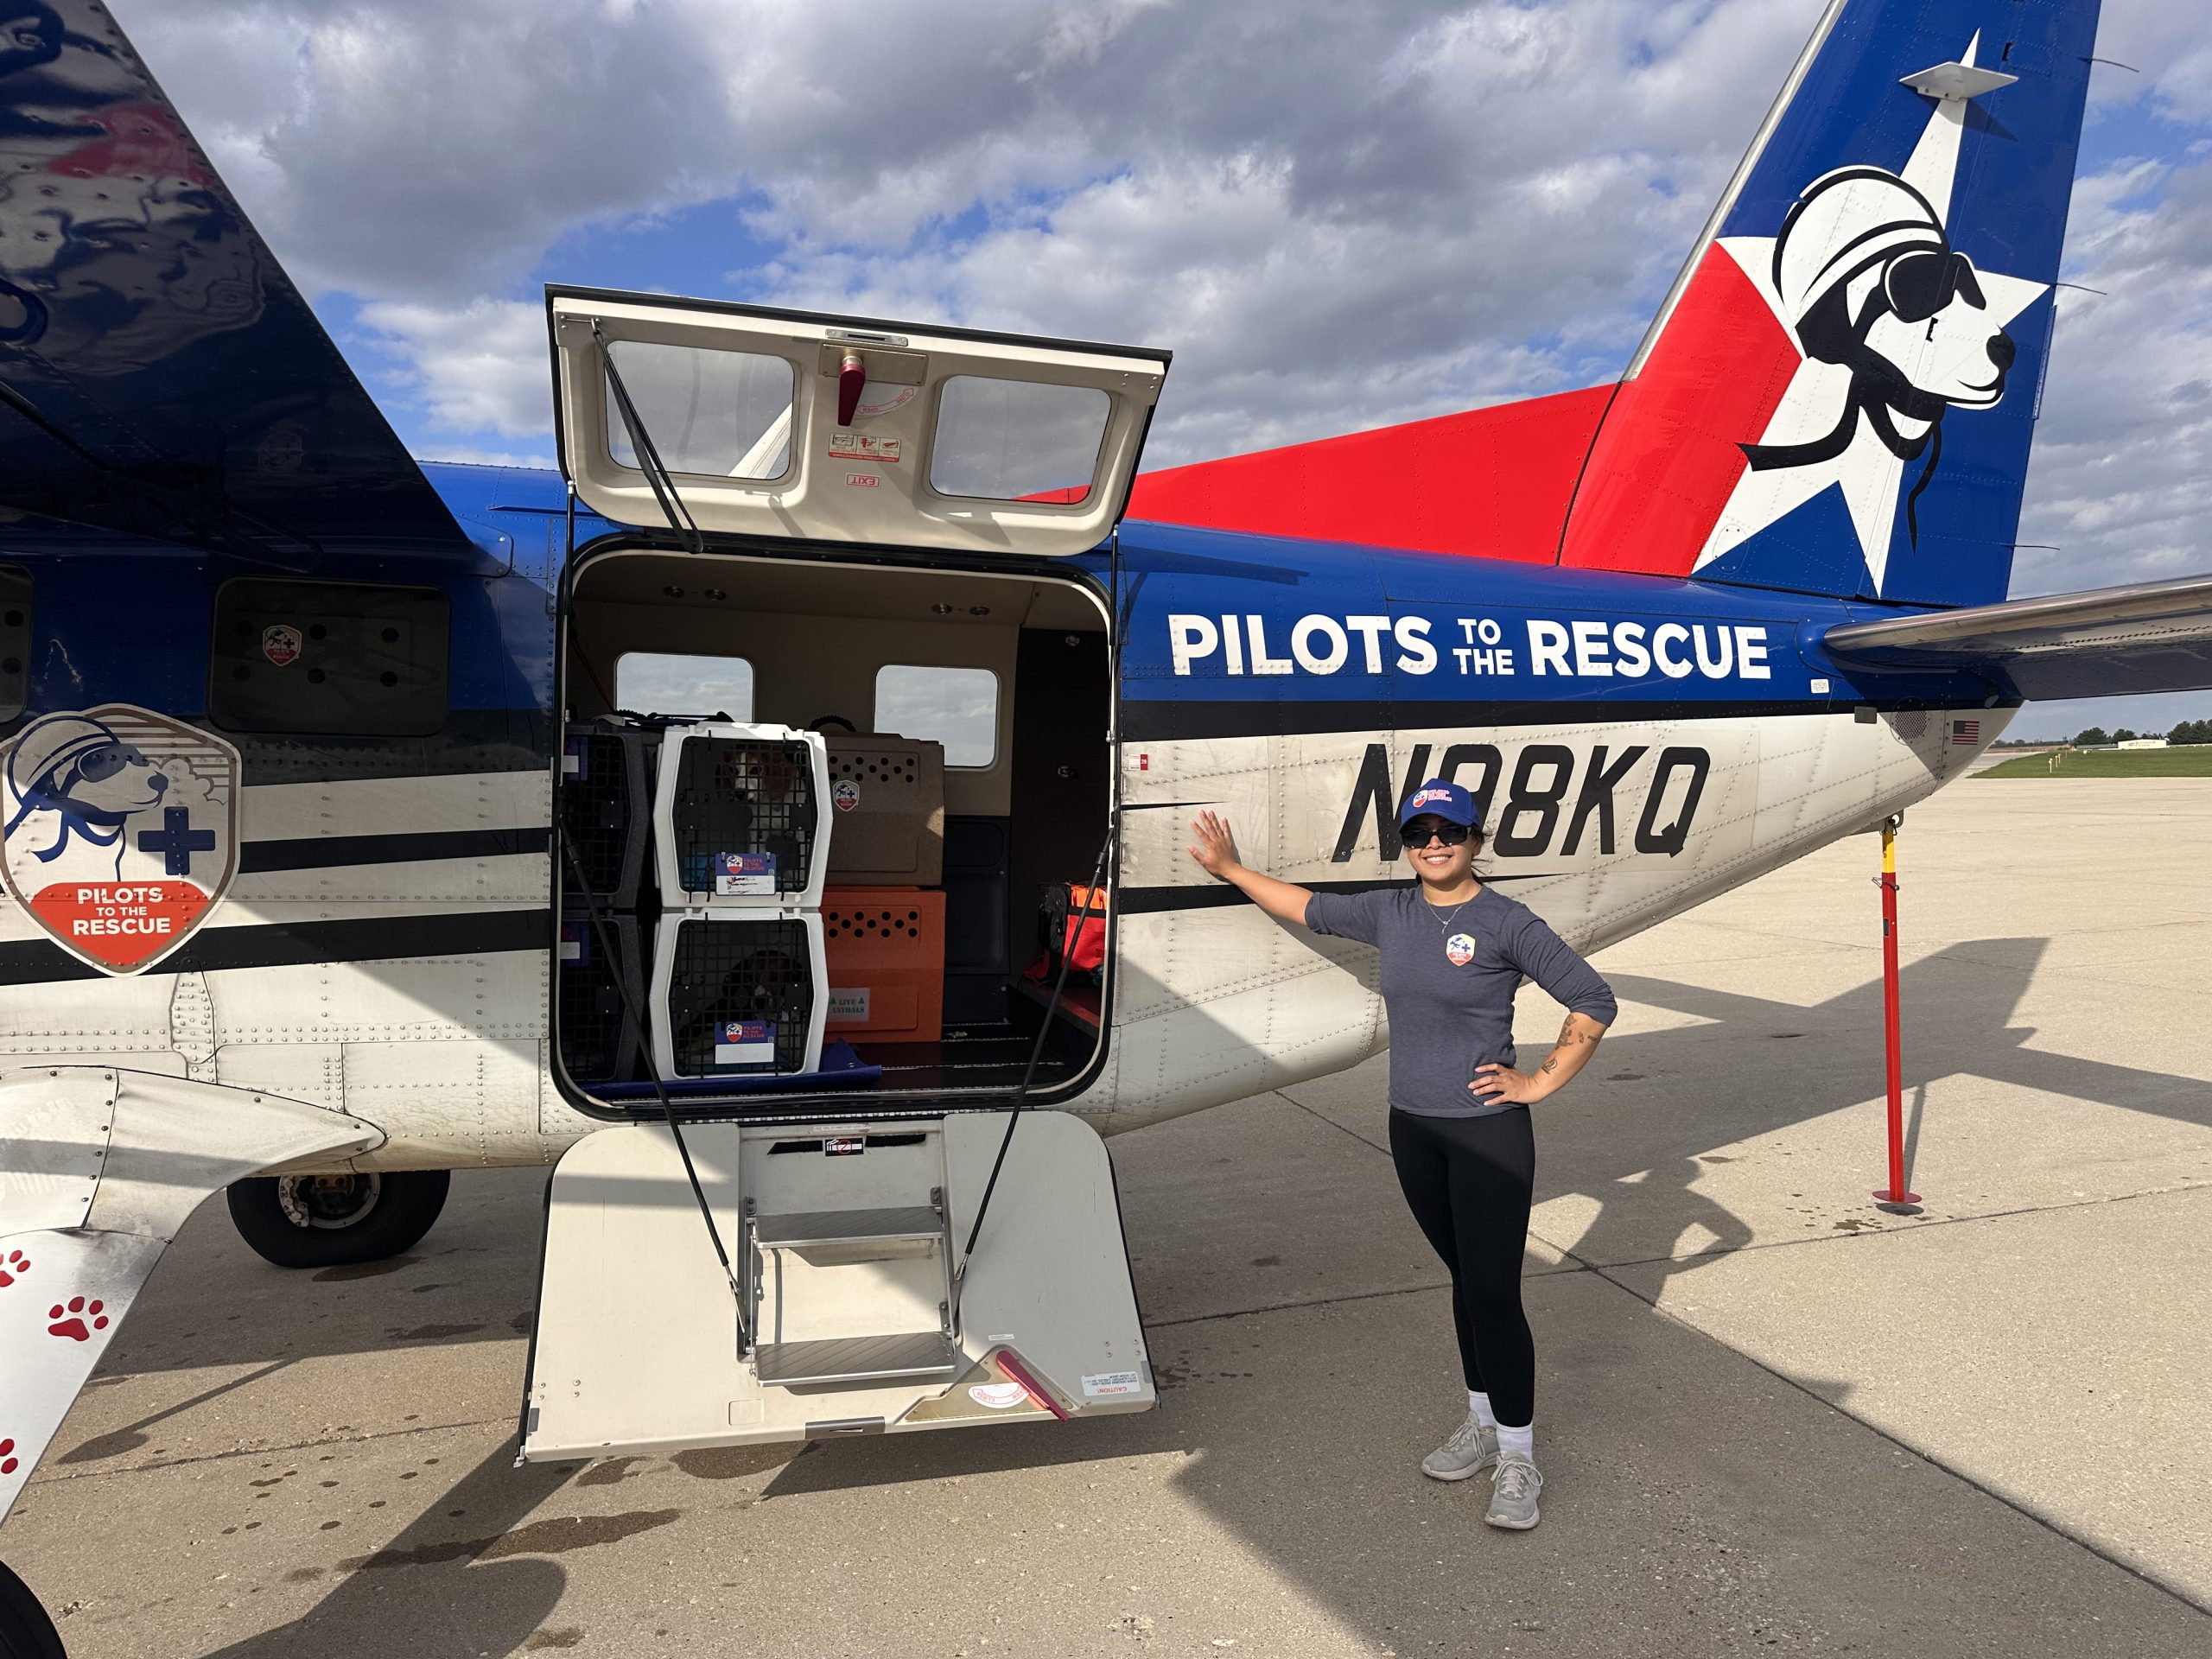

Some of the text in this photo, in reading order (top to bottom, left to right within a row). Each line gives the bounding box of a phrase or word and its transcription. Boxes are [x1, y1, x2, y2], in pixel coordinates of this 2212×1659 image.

[852, 476, 876, 486] EXIT
[1167, 613, 1771, 679] PILOTS TO THE RESCUE
[77, 887, 164, 905] PILOTS
[95, 906, 148, 917] TO THE
[73, 917, 171, 936] RESCUE
